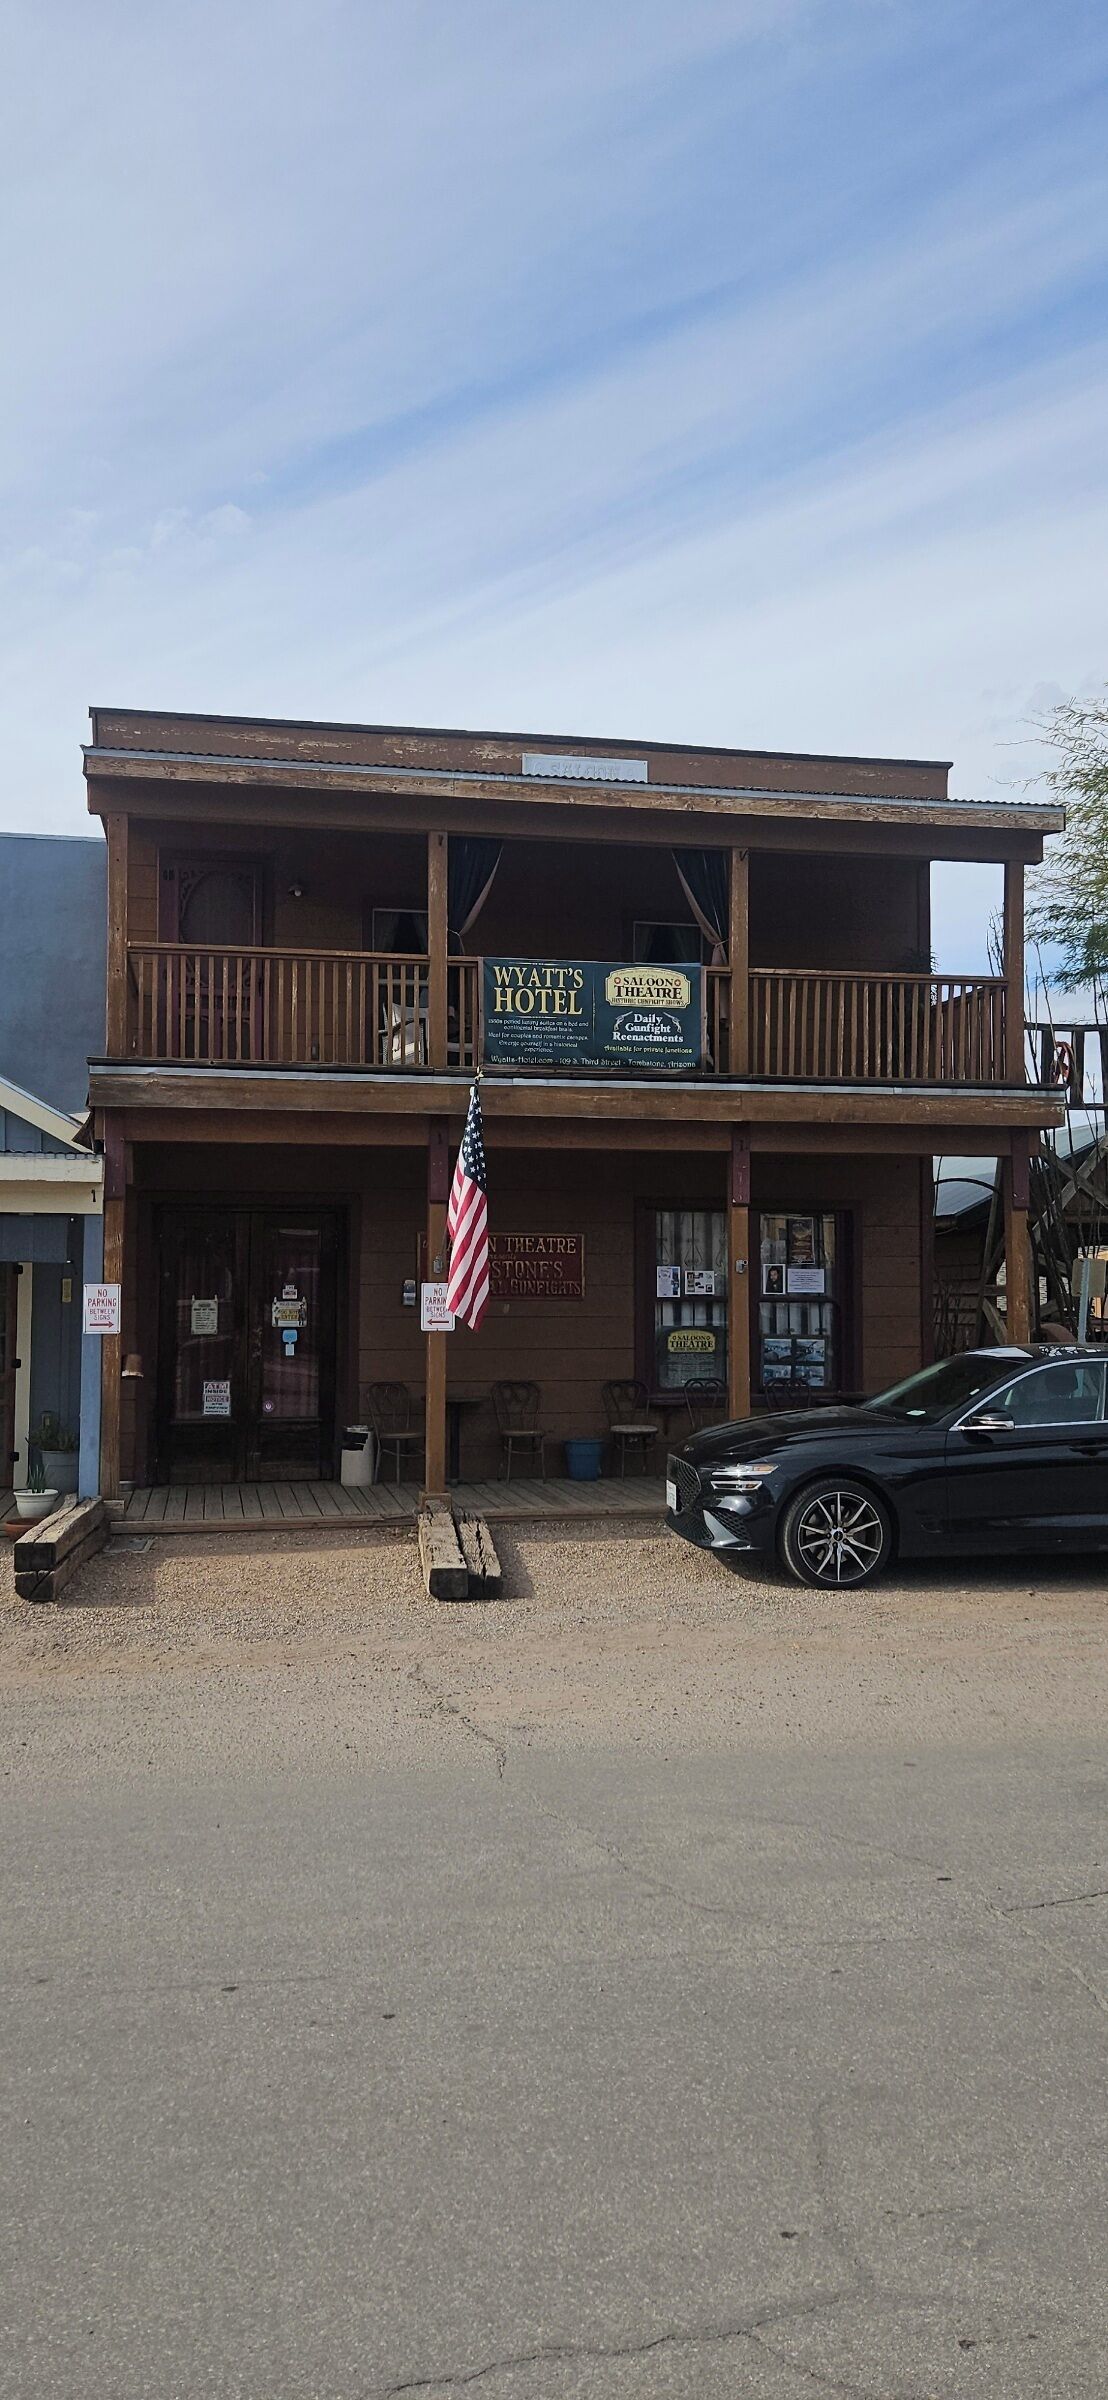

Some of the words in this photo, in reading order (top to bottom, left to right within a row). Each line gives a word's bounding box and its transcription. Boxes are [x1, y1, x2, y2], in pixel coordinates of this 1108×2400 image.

[493, 966, 584, 989] WYATT'S
[623, 976, 674, 987] SALOON
[614, 985, 683, 1000] THEATRE
[493, 987, 583, 1015] HOTEL
[637, 998, 664, 1006] GUNFIGHT
[633, 1013, 663, 1025] Daily
[625, 1022, 671, 1035] Gunfight
[612, 1031, 684, 1043] Reenactments
[603, 1045, 633, 1053] Available
[581, 1058, 599, 1066] Third
[667, 1060, 696, 1068] Arizona
[504, 1237, 577, 1255] THEATRE
[488, 1260, 564, 1280] STONE'S
[433, 1287, 443, 1297] NO
[510, 1278, 581, 1295] GUNFIGHTS
[97, 1288, 108, 1298] NO
[87, 1298, 117, 1307] PARKING
[425, 1296, 447, 1306] PARKIN
[669, 1340, 714, 1348] THEATRE
